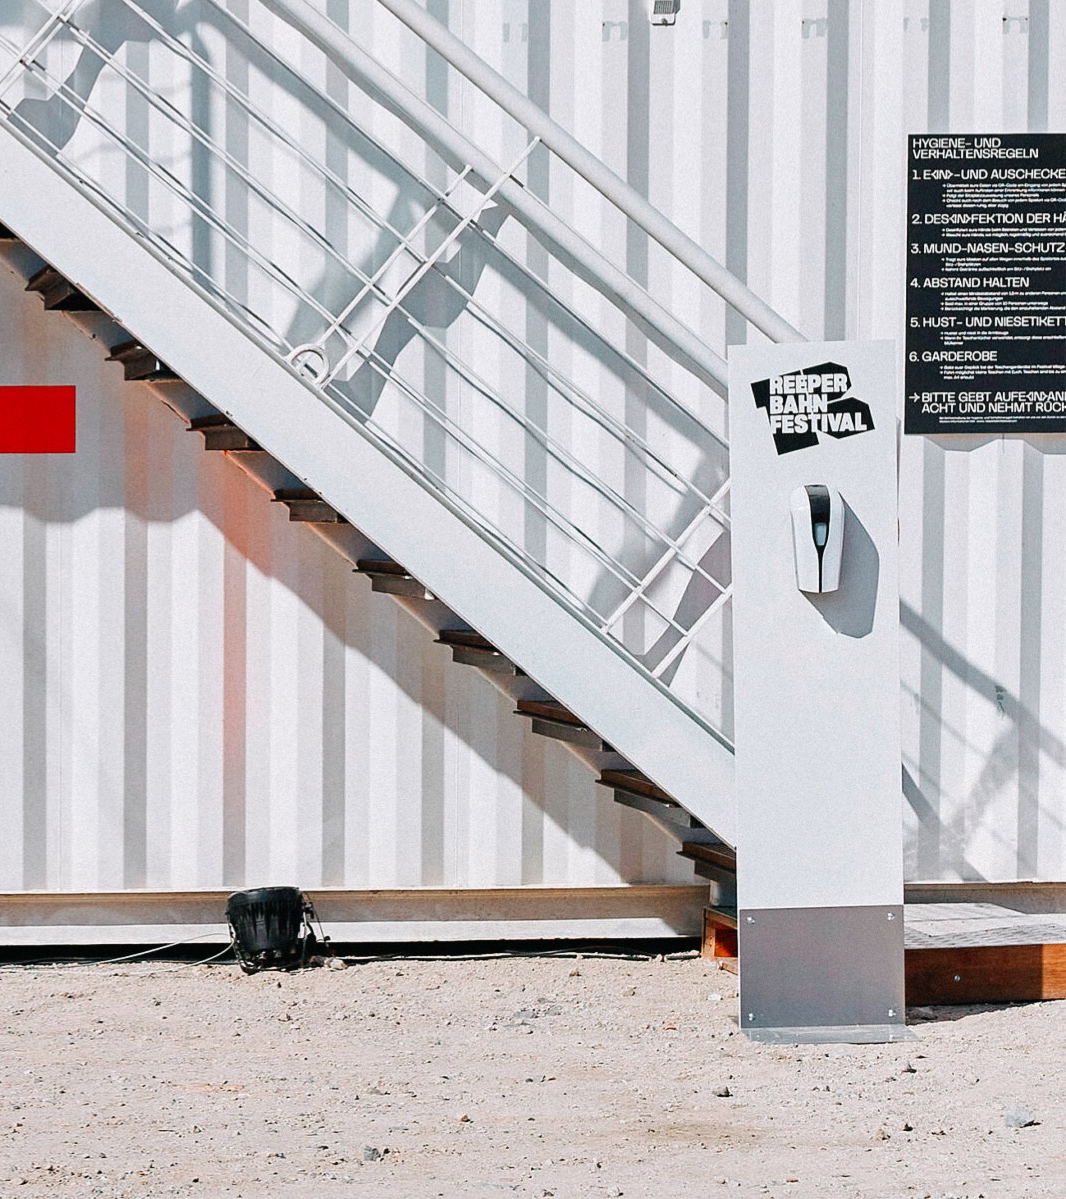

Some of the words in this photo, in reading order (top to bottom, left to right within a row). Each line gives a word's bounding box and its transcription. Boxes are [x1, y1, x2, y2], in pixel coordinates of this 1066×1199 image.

[974, 137, 1002, 148] UND
[912, 148, 1039, 159] VERHALTENSREGELN
[912, 169, 921, 180] 1.
[911, 213, 922, 225] 2.
[1026, 212, 1051, 224] DER
[910, 243, 921, 254] 3.
[910, 277, 921, 288] 4.
[923, 277, 981, 288] ABSTAND
[983, 276, 1030, 287] HALTEN
[910, 317, 921, 328] 5.
[922, 316, 963, 328] HUST-
[965, 316, 992, 327] UND
[909, 351, 920, 362] 6.
[921, 350, 998, 362] GARDEROBE
[769, 373, 848, 395] REEPER
[921, 391, 956, 403] BITTE
[958, 391, 992, 402] GEBT
[769, 394, 828, 415] BAHN
[921, 402, 956, 414] ACHT
[958, 402, 985, 413] UND
[988, 402, 1033, 413] NEHMT
[770, 412, 867, 434] FESTIVAL
